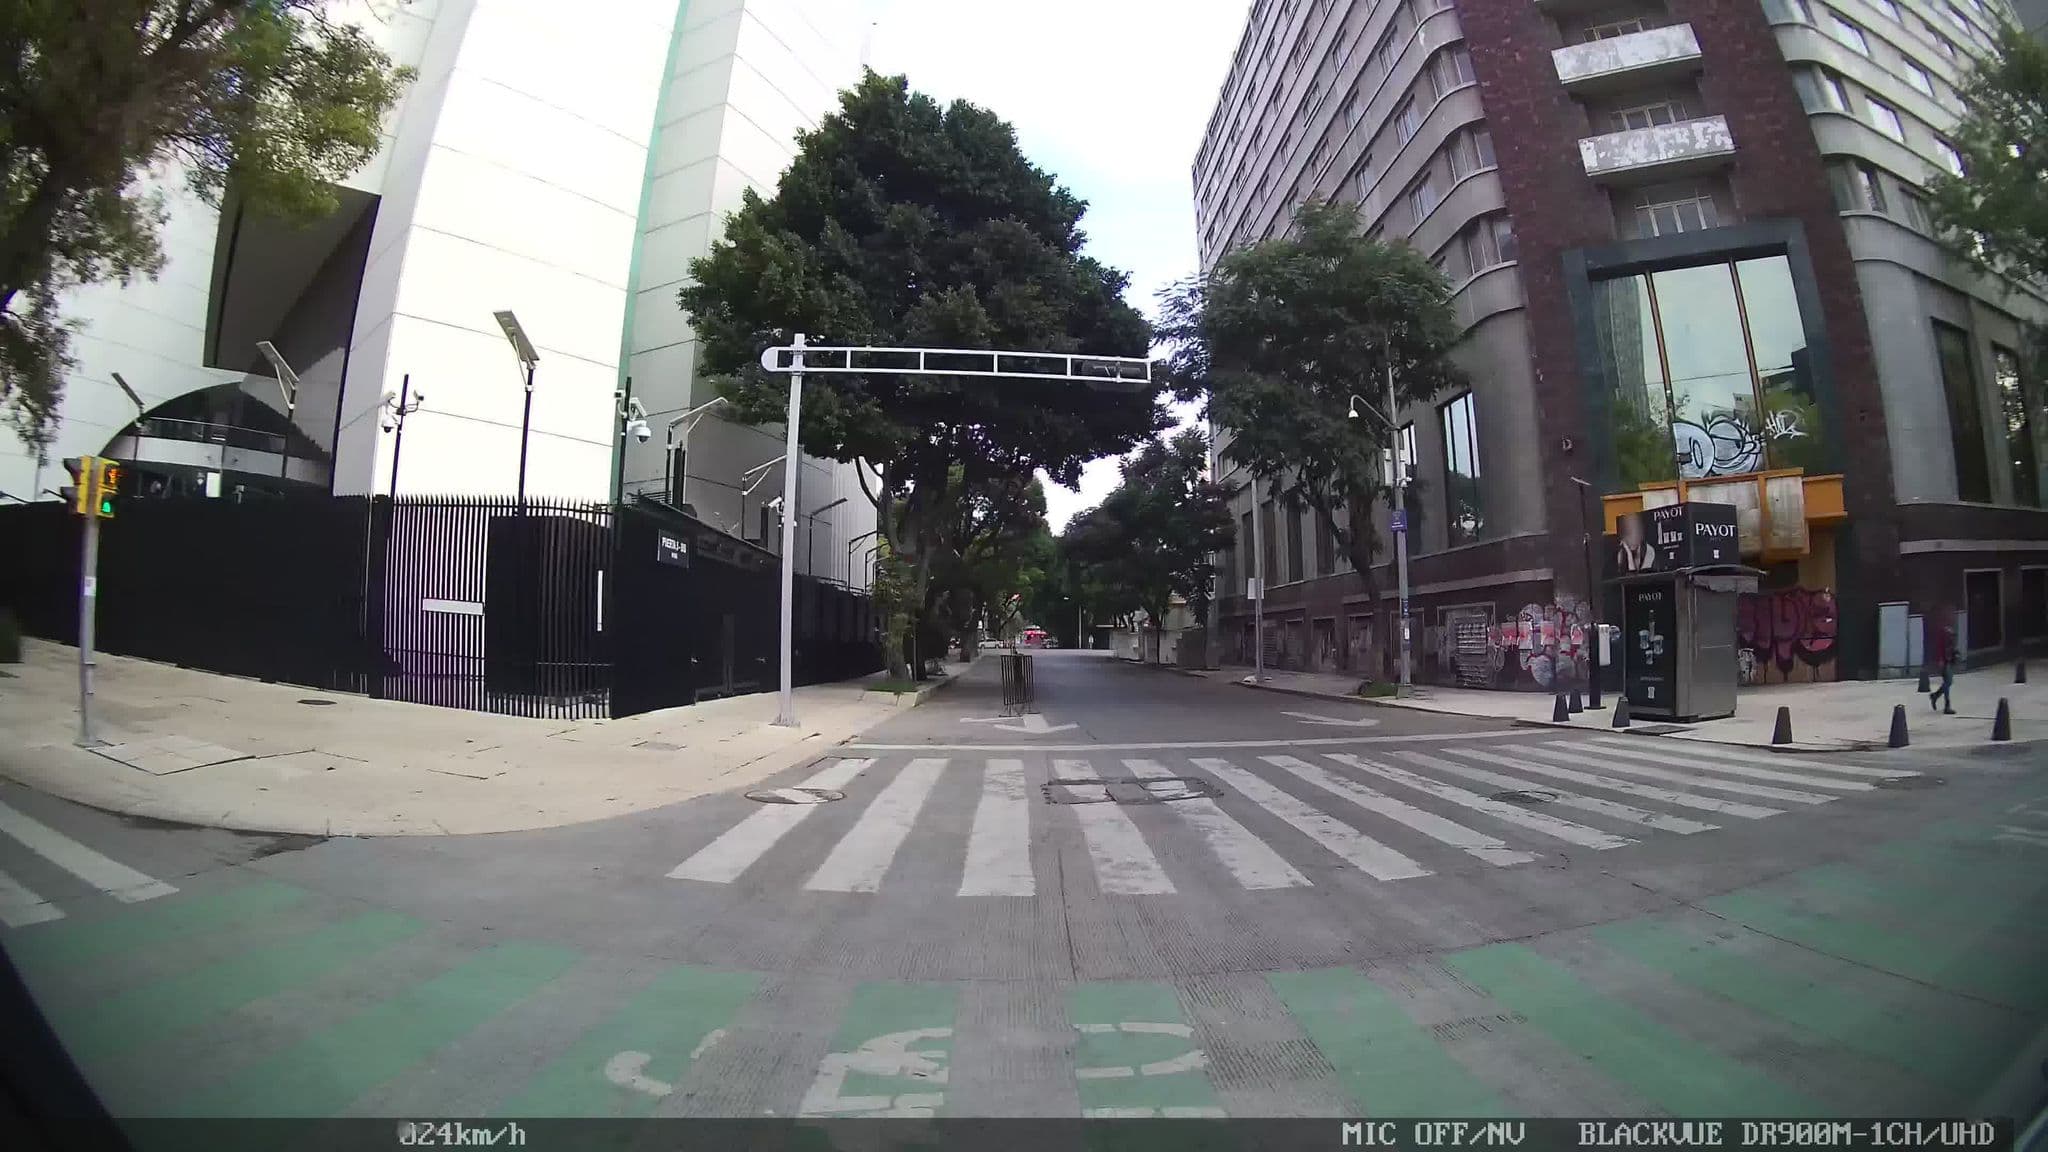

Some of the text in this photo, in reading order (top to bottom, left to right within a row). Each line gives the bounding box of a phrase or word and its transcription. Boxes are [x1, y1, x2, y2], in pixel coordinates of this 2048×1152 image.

[1653, 507, 1683, 521] PAYOT
[1695, 523, 1736, 537] PAYOT
[1638, 592, 1662, 602] PAYOT
